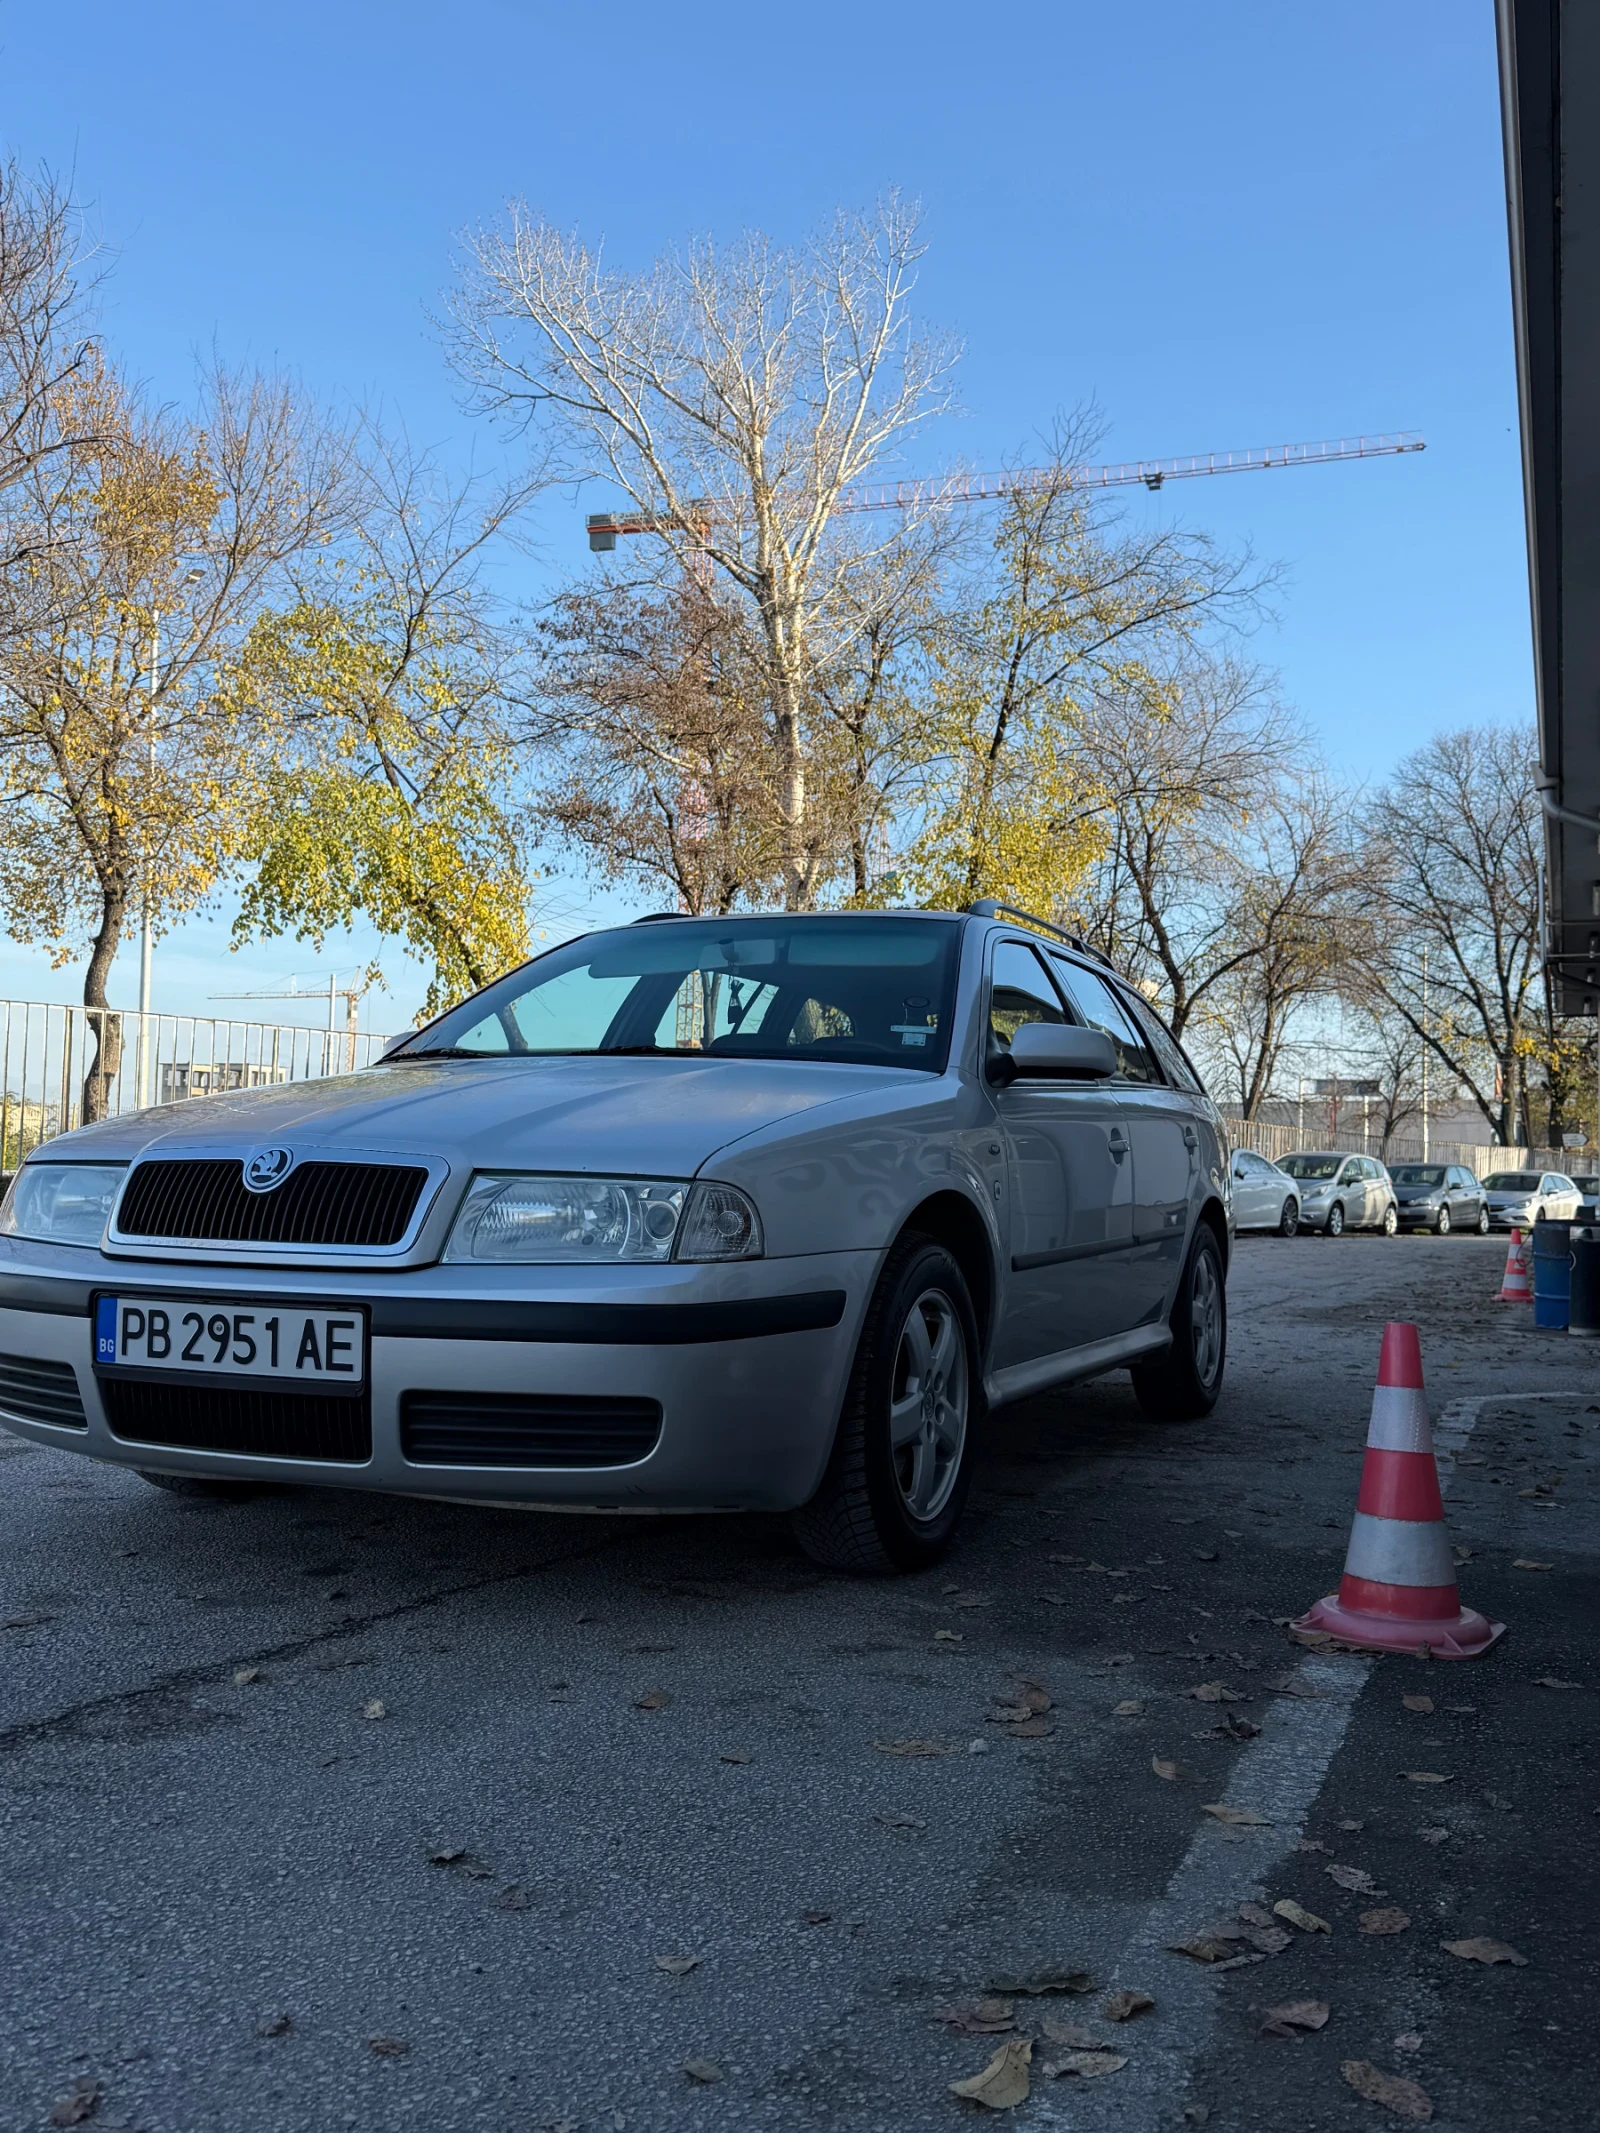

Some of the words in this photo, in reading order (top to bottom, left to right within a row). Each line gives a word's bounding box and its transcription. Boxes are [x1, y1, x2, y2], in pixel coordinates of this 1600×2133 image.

[99, 1338, 114, 1353] BG
[121, 1307, 171, 1359] PB
[181, 1312, 279, 1368] 2951
[295, 1318, 355, 1372] AE
